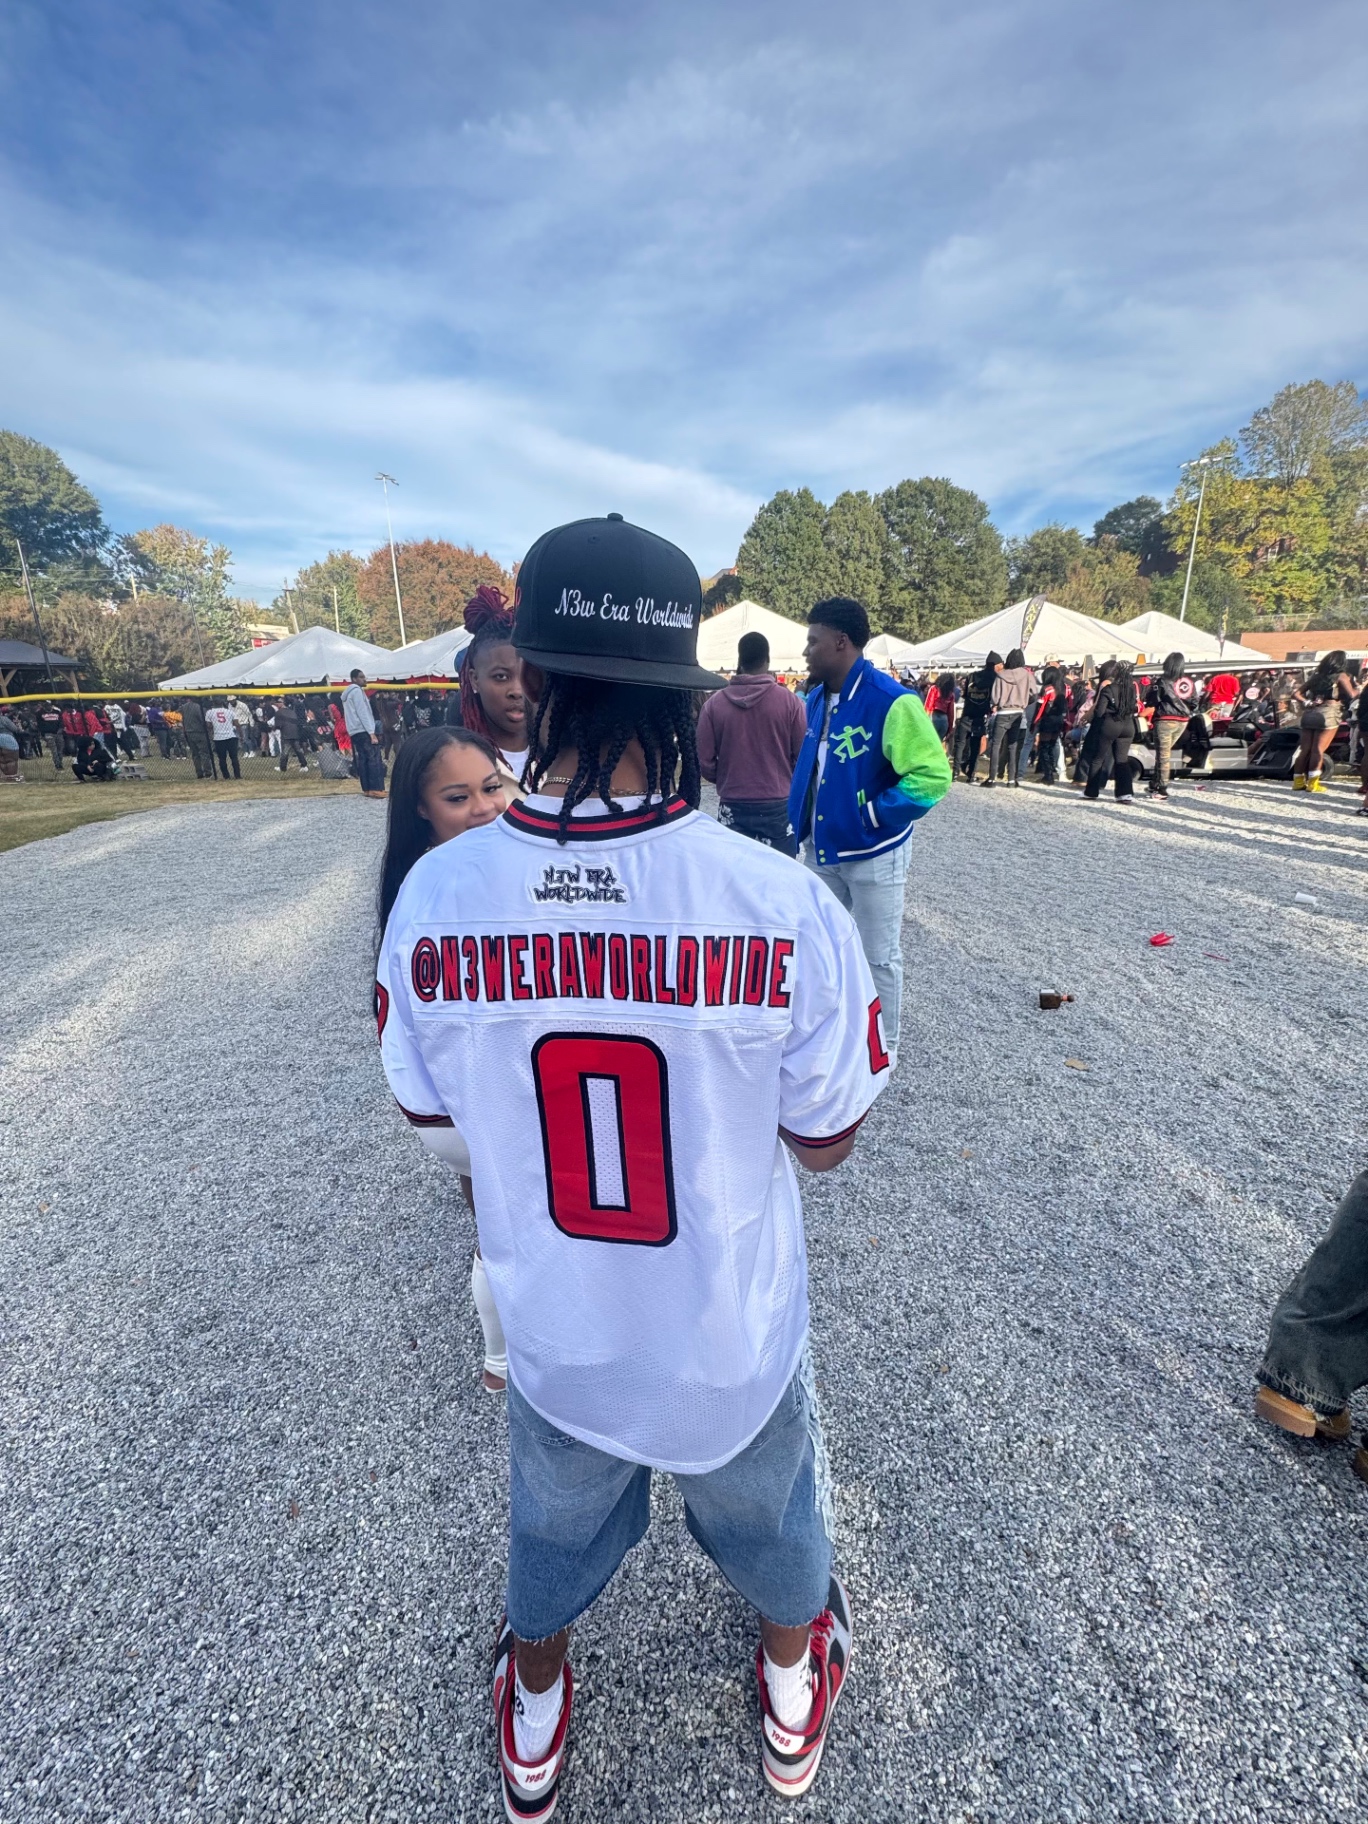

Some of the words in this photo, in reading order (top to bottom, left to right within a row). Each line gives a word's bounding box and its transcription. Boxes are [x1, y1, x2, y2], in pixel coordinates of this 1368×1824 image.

[555, 588, 596, 618] N3w
[600, 593, 631, 621] Era
[635, 597, 694, 629] Worldwide
[216, 712, 227, 724] 5
[585, 866, 617, 888] ERA
[533, 882, 627, 904] WORLDWIDE
[411, 932, 794, 1008] @N3WERAWORLDWIDE
[531, 1031, 678, 1247] 0
[771, 1729, 792, 1747] 1988
